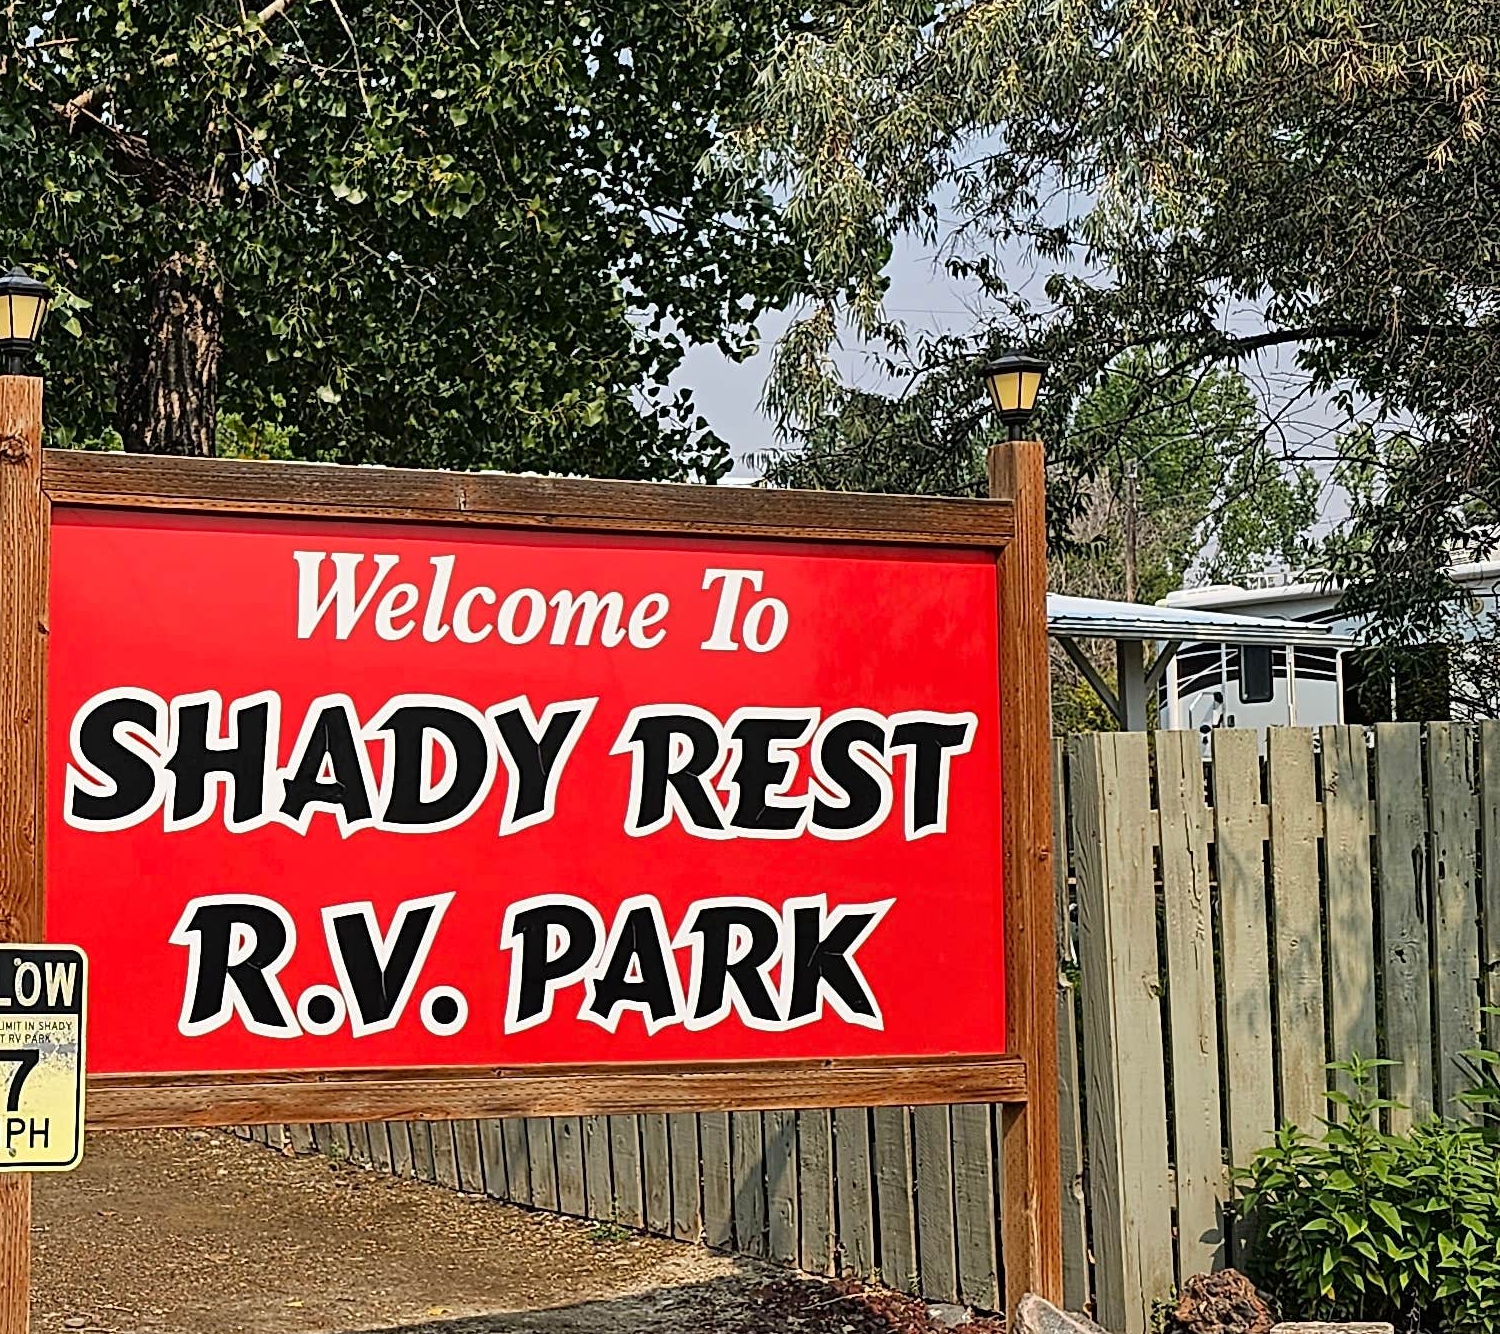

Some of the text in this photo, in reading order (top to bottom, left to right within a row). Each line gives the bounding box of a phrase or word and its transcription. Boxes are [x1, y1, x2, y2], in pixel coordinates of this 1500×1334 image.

[293, 550, 790, 653] Welcome To
[65, 686, 979, 840] SHADY REST
[169, 891, 896, 1037] R.V. PARK
[8, 1033, 22, 1044] RV
[24, 1033, 51, 1044] PARK
[24, 1021, 35, 1031] IN
[38, 1021, 73, 1031] SHADY
